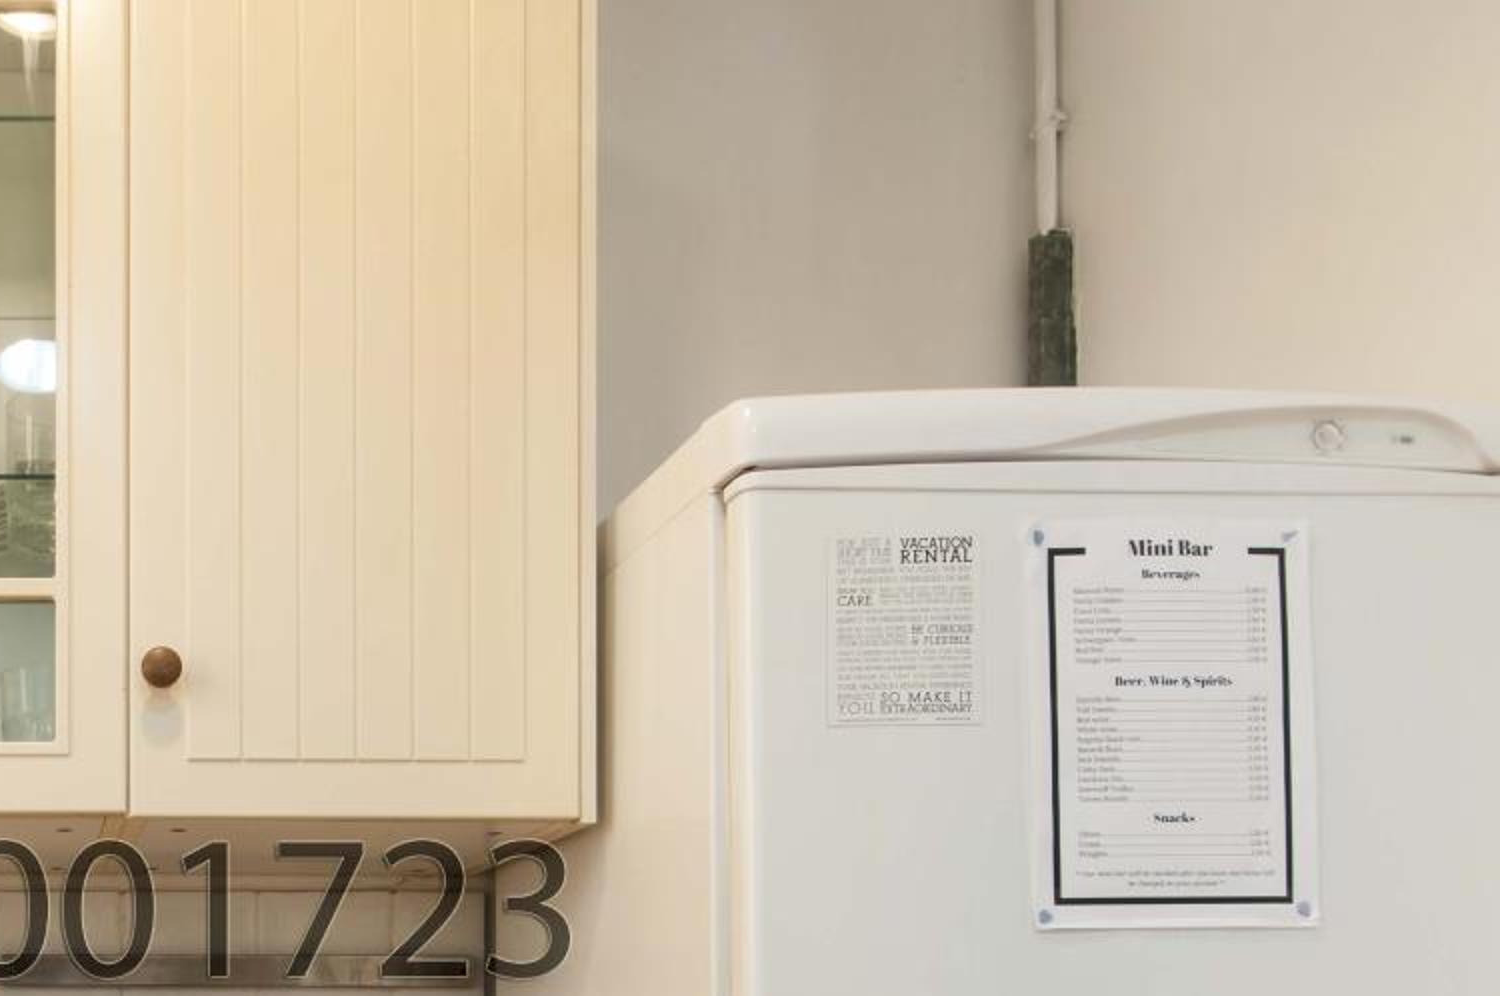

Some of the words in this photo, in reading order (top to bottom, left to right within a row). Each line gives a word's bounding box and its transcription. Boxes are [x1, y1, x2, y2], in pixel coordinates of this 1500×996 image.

[900, 536, 973, 549] VACATION
[1128, 539, 1174, 557] Mini
[1179, 540, 1214, 557] Bar
[900, 550, 973, 564] RENTAL
[1141, 569, 1201, 580] Beverages
[837, 595, 874, 607] CARE
[1149, 675, 1179, 687] Wine
[1194, 675, 1233, 688] Spirits
[882, 692, 901, 703] SO
[908, 692, 951, 703] MAKE
[959, 691, 973, 703] IT
[1153, 812, 1196, 824] Snacks
